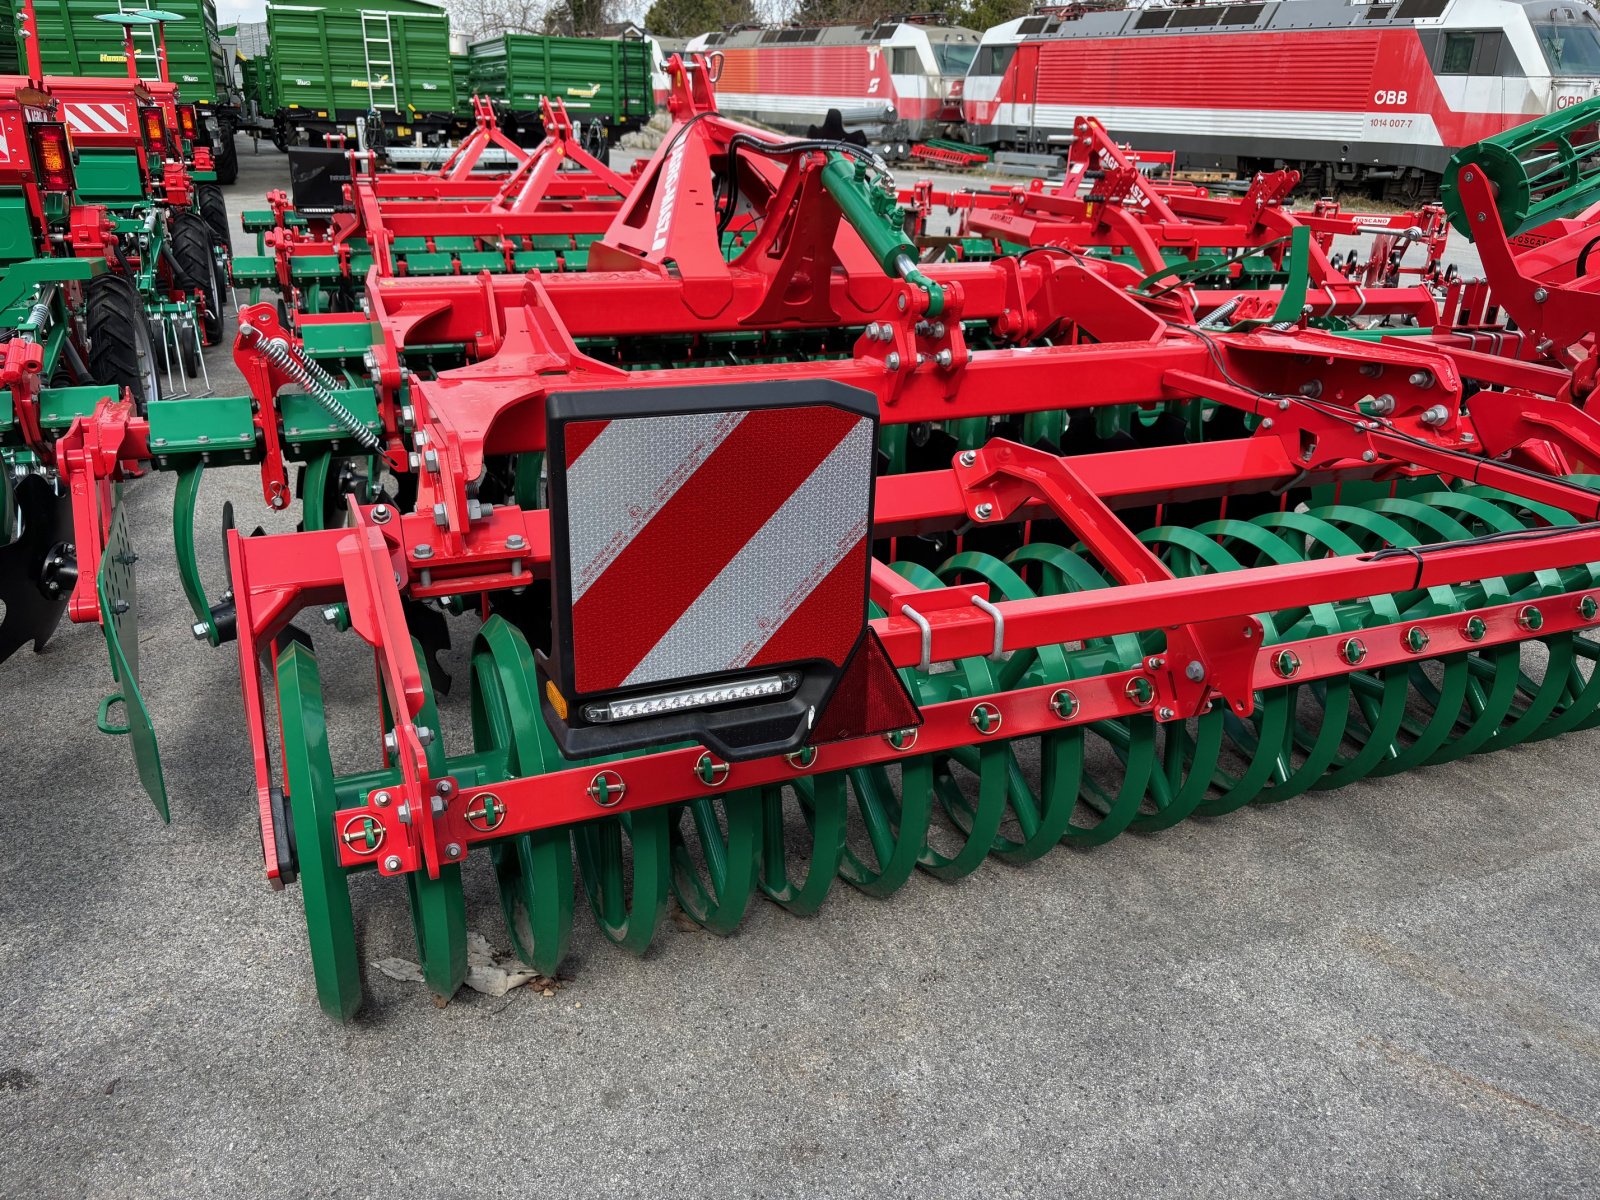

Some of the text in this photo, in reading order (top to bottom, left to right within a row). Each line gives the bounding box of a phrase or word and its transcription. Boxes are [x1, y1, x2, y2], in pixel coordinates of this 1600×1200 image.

[1374, 90, 1408, 105] ÖBB
[1370, 118, 1413, 128] 1014 007-7
[1512, 234, 1549, 246] TOSCAN
